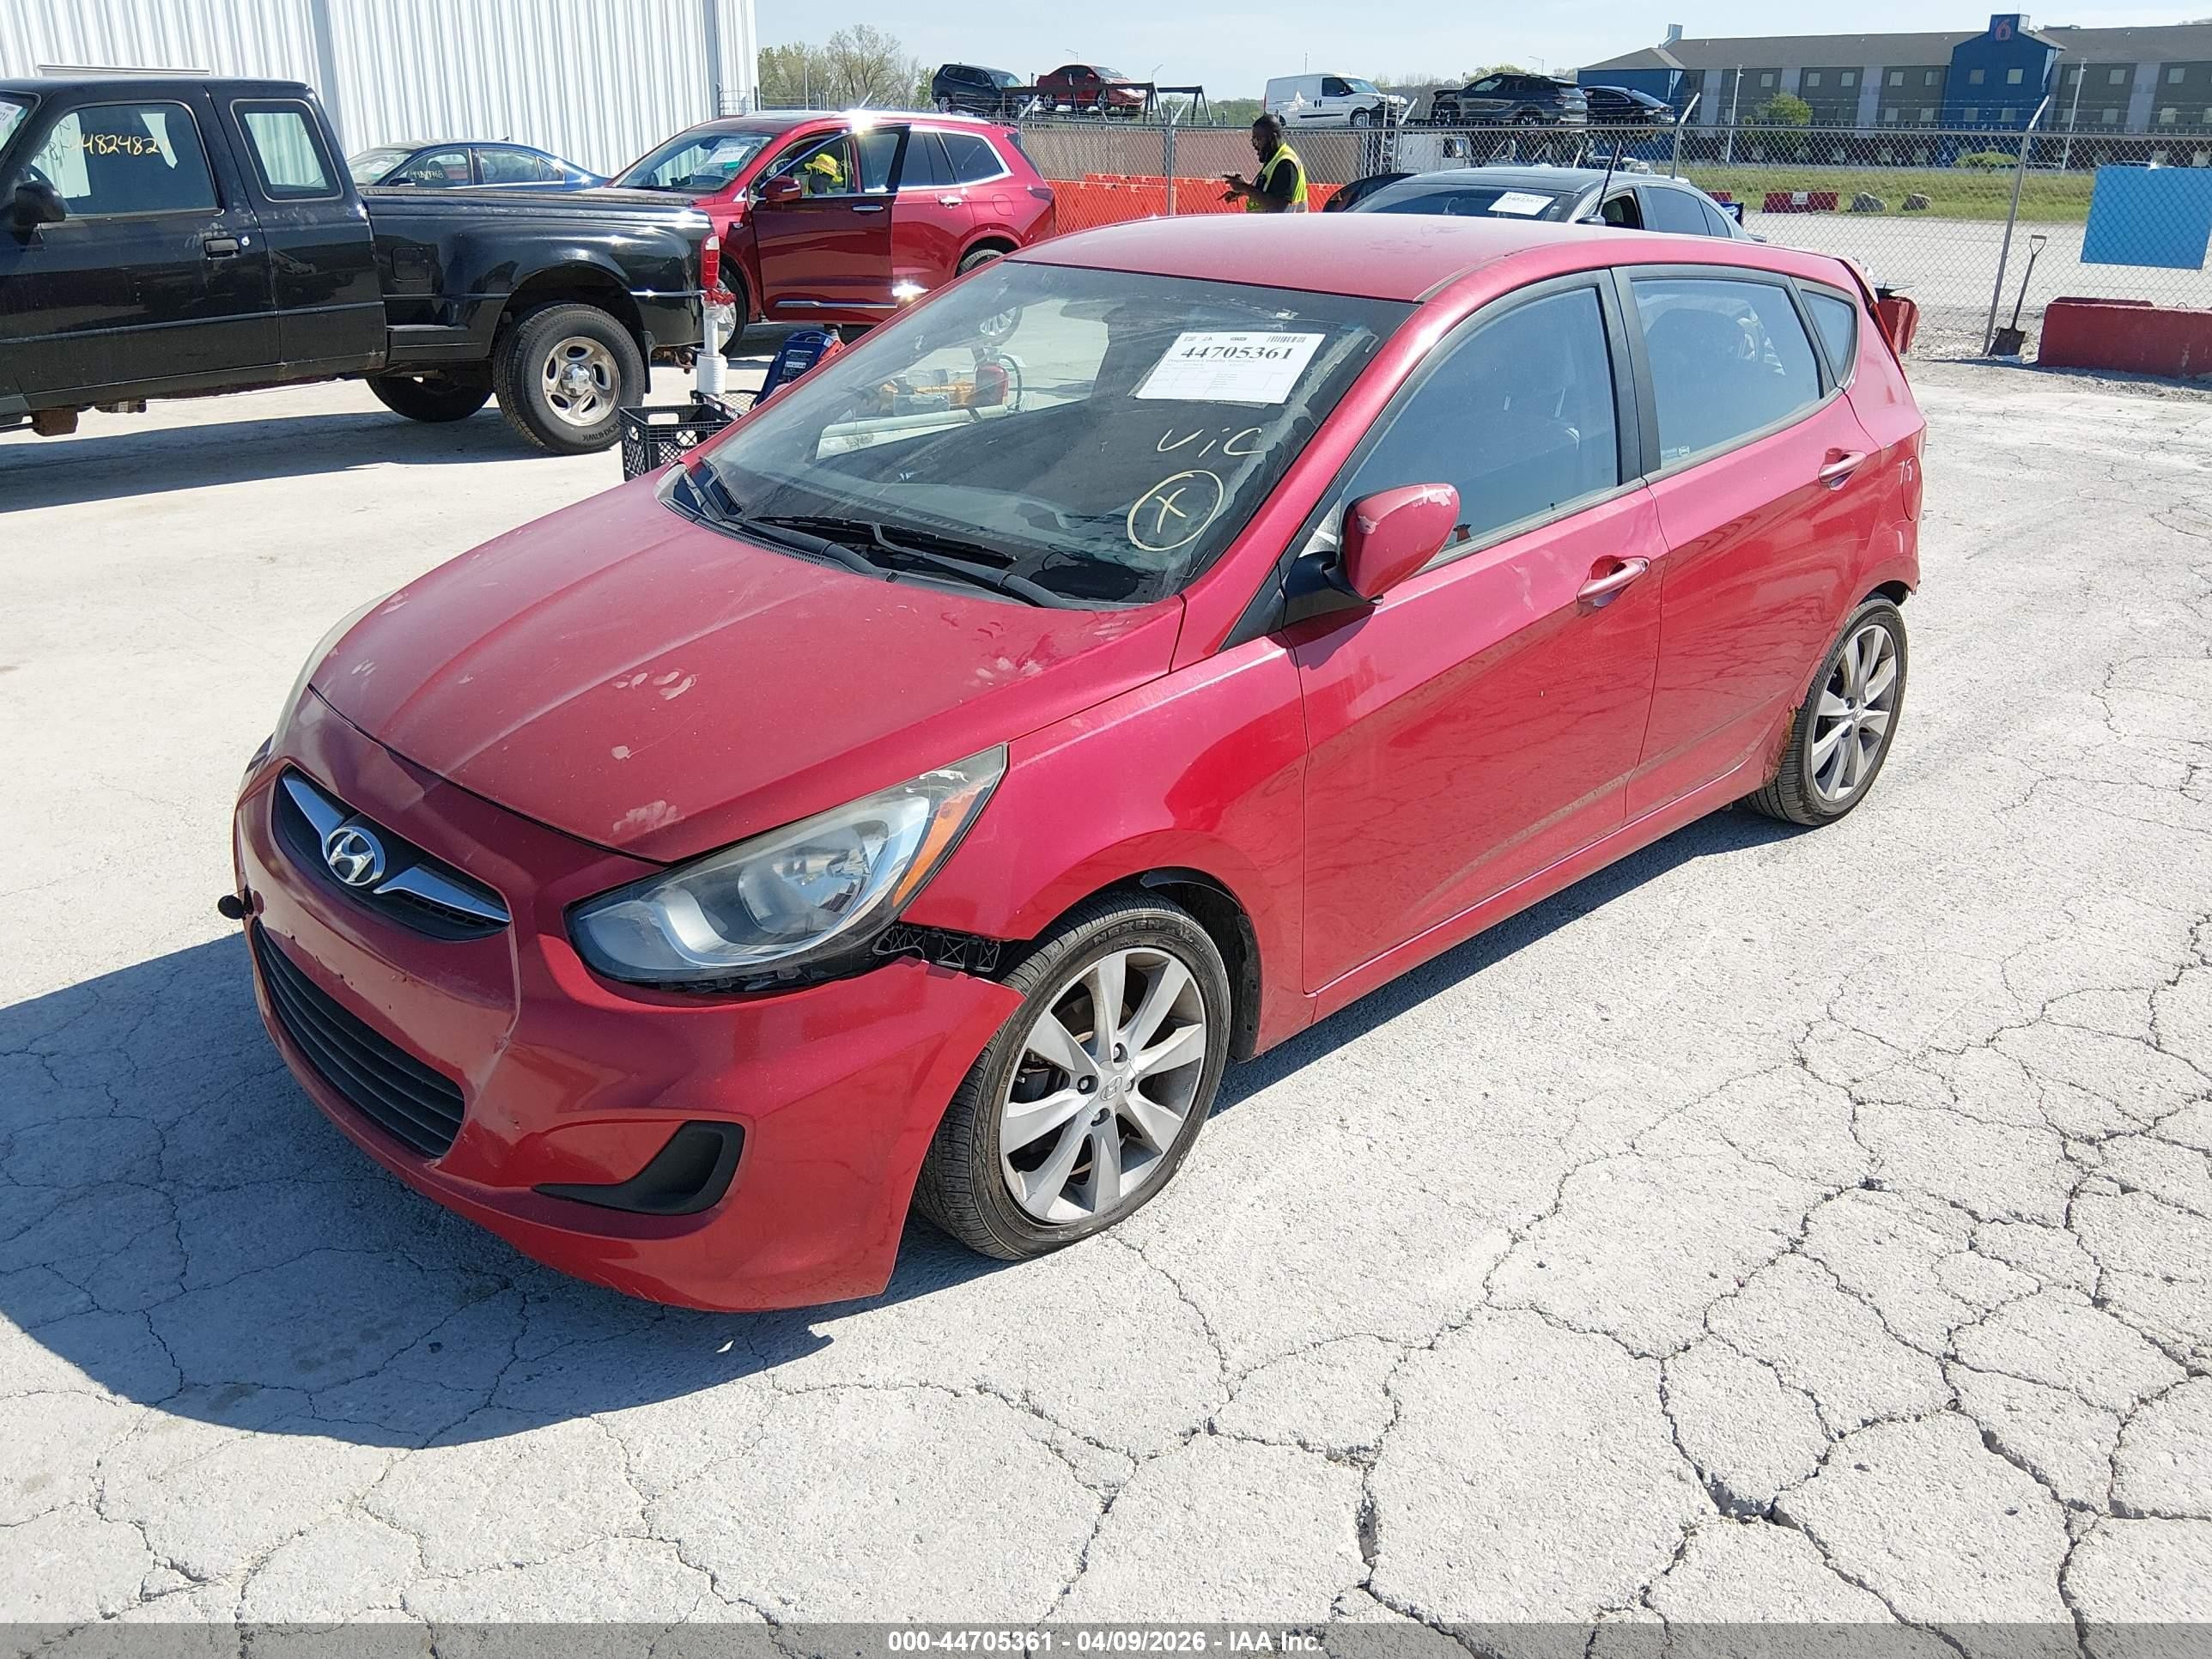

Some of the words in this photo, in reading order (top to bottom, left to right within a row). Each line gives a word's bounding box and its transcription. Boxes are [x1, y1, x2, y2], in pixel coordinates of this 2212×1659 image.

[1996, 19, 2011, 41] 6
[1180, 346, 1294, 360] 44705361
[1093, 920, 1160, 945] NEXEN
